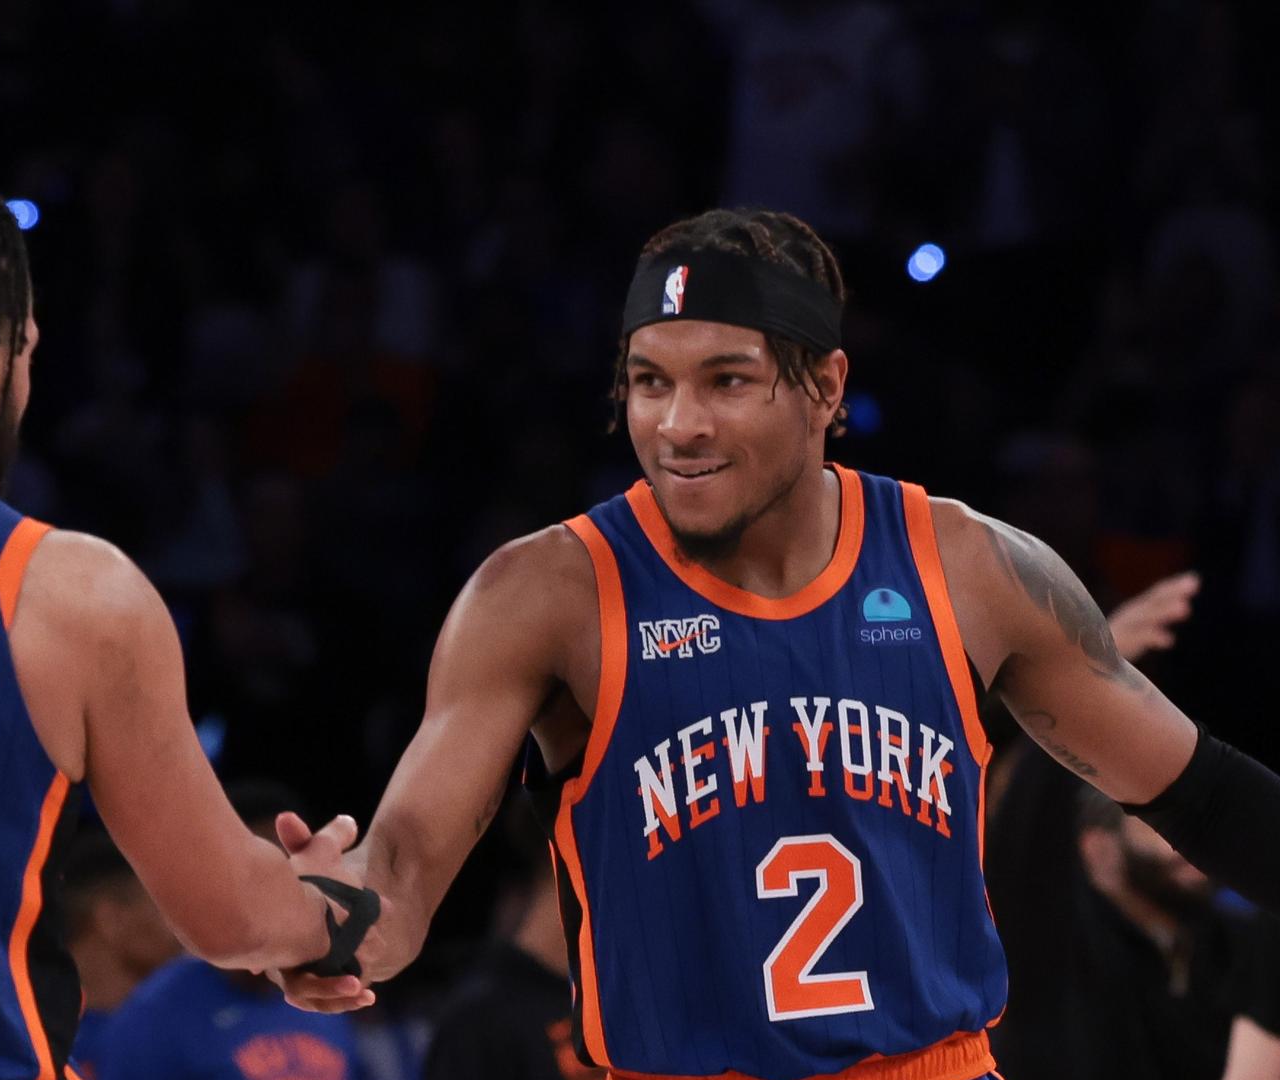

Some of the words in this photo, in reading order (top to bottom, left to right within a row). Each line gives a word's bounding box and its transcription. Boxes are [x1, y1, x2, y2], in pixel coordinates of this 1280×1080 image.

[638, 614, 721, 660] NYC
[860, 626, 922, 645] sphere
[633, 701, 768, 837] NEW
[789, 697, 954, 816] YORK
[756, 833, 875, 1022] 2
